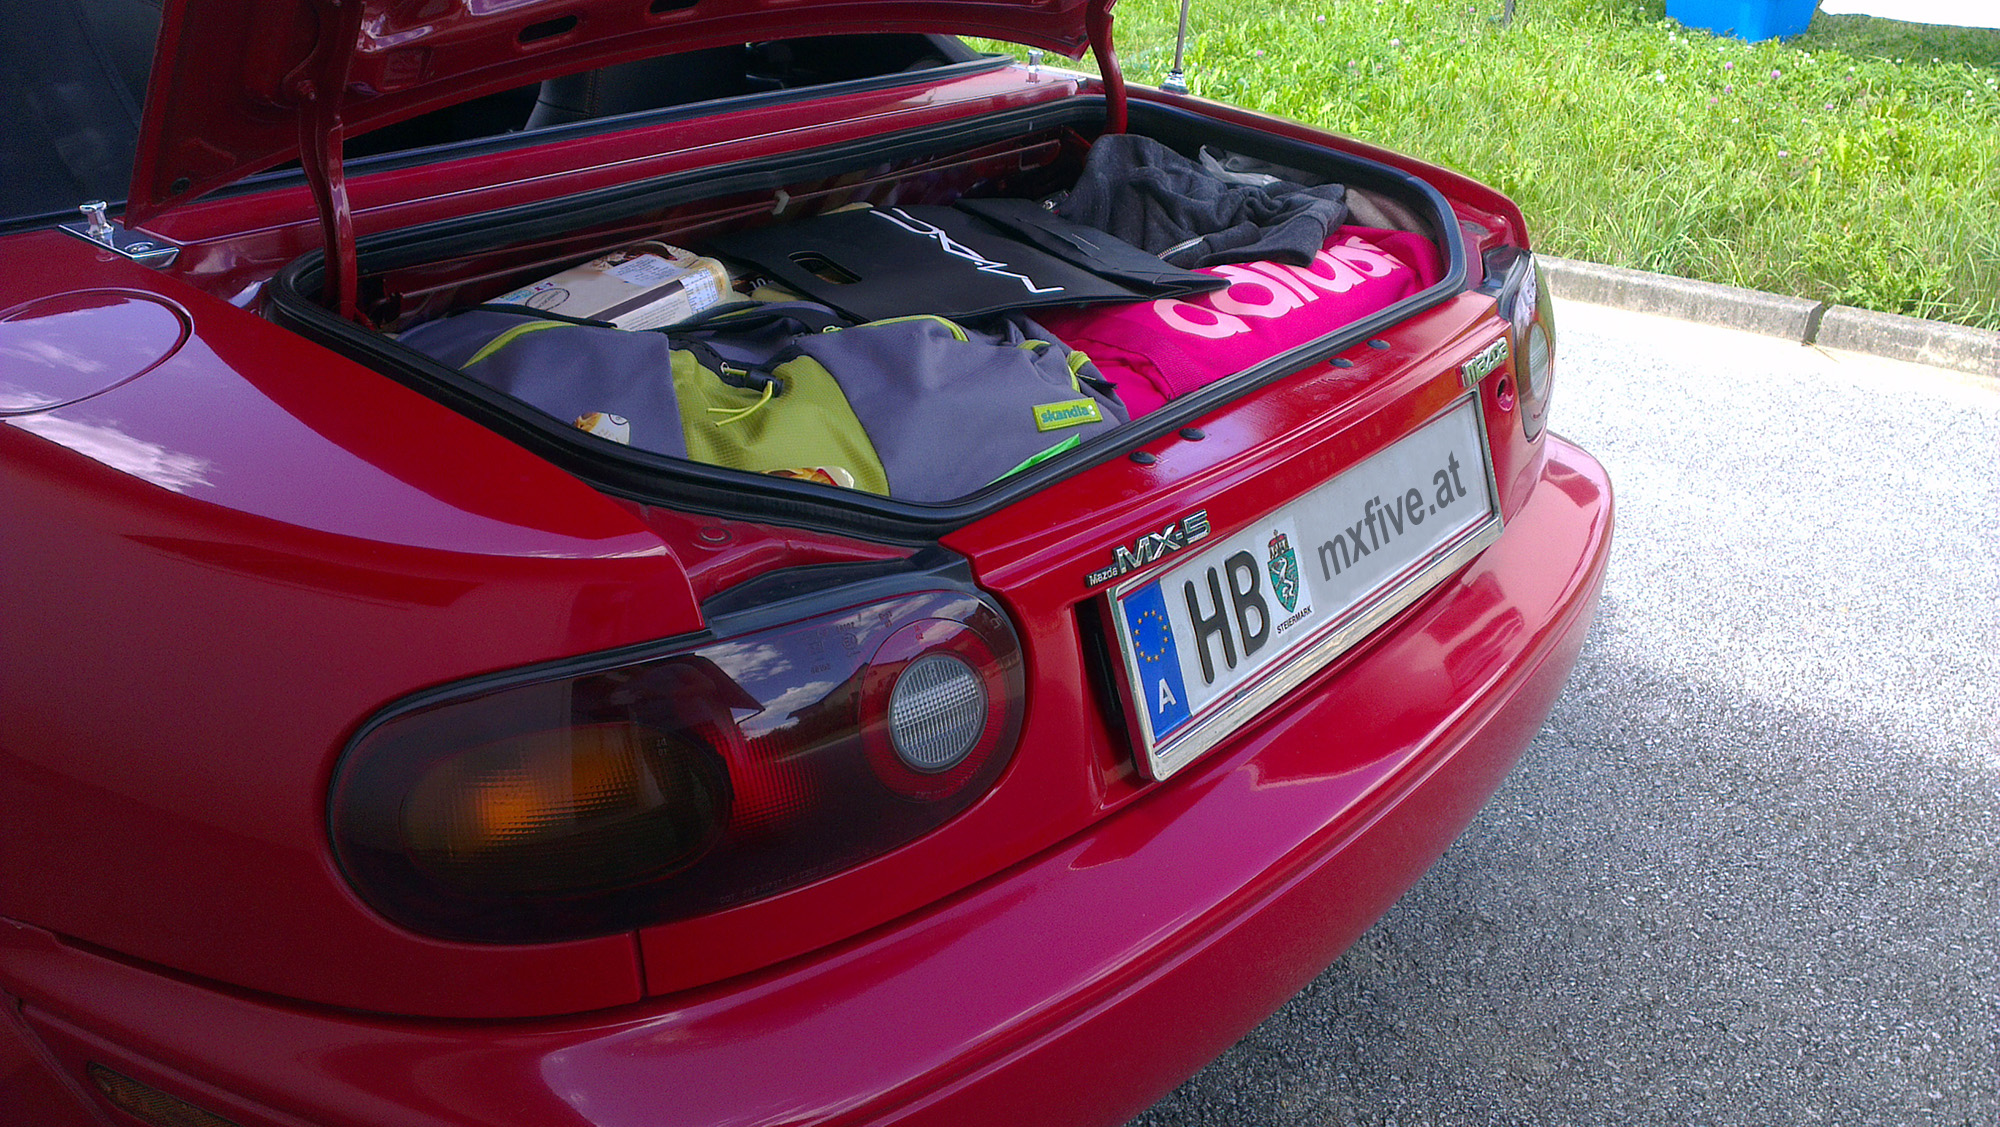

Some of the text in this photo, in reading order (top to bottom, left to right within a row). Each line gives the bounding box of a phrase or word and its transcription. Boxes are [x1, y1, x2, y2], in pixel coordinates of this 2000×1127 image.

[1088, 509, 1211, 586] Mazda MX-5
[1184, 450, 1467, 685] HB mxfive.at
[1277, 605, 1312, 634] STEIERMARK
[1159, 677, 1177, 714] A
